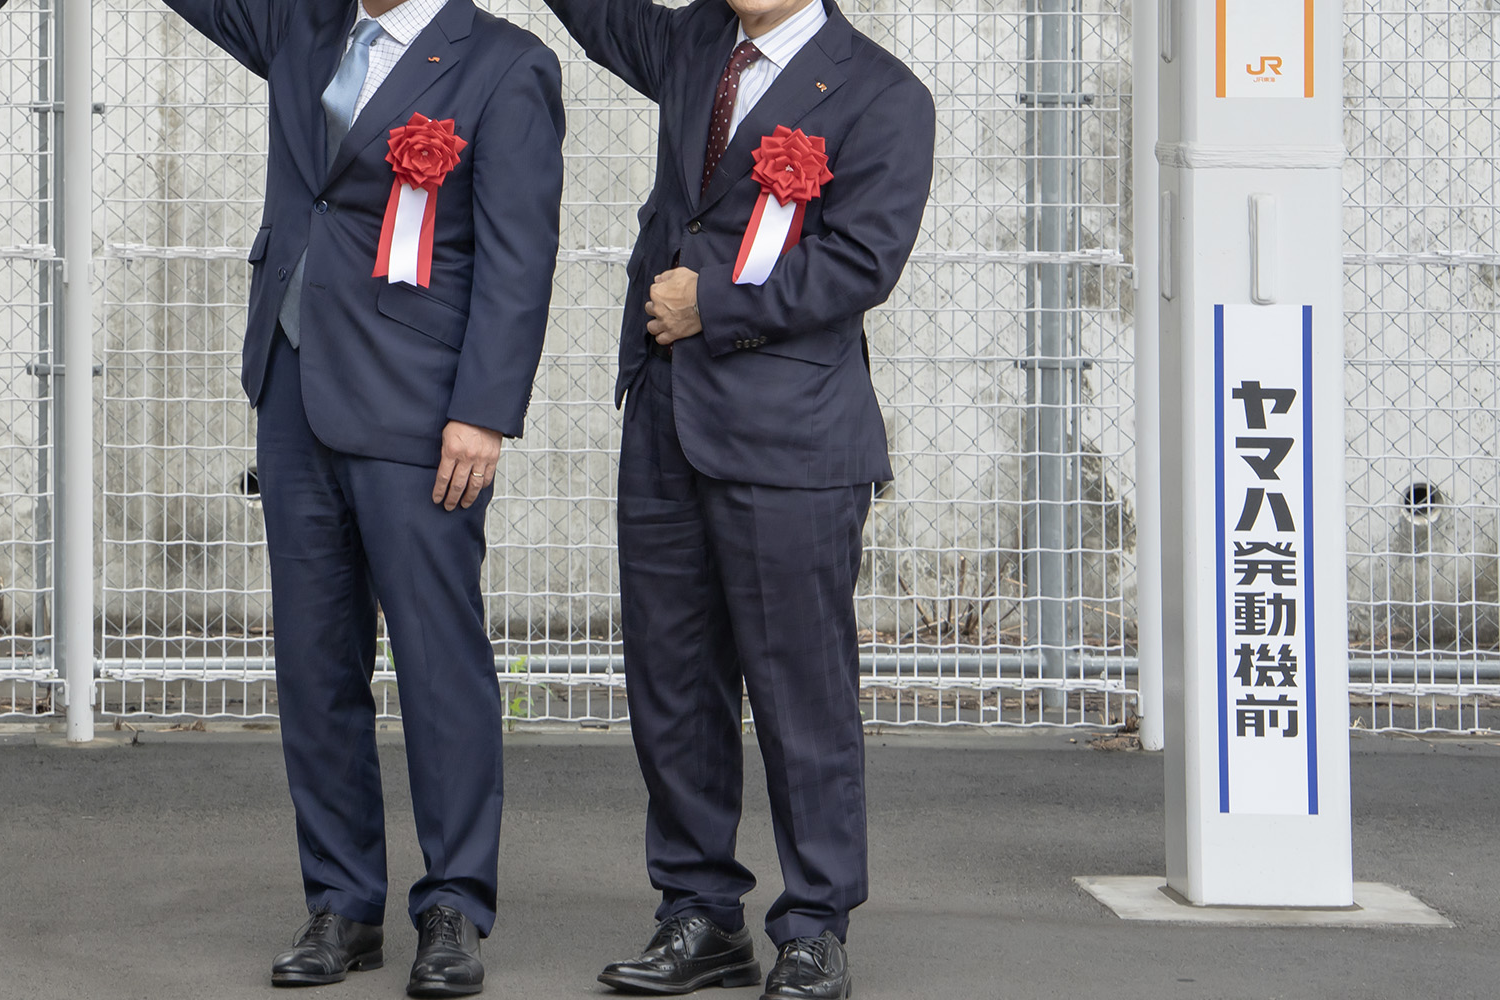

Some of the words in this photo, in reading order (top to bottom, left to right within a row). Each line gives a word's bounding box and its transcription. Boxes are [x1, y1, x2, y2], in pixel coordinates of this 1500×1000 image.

[1246, 55, 1283, 76] JR
[1231, 380, 1299, 738] ヤマハ発動機前
